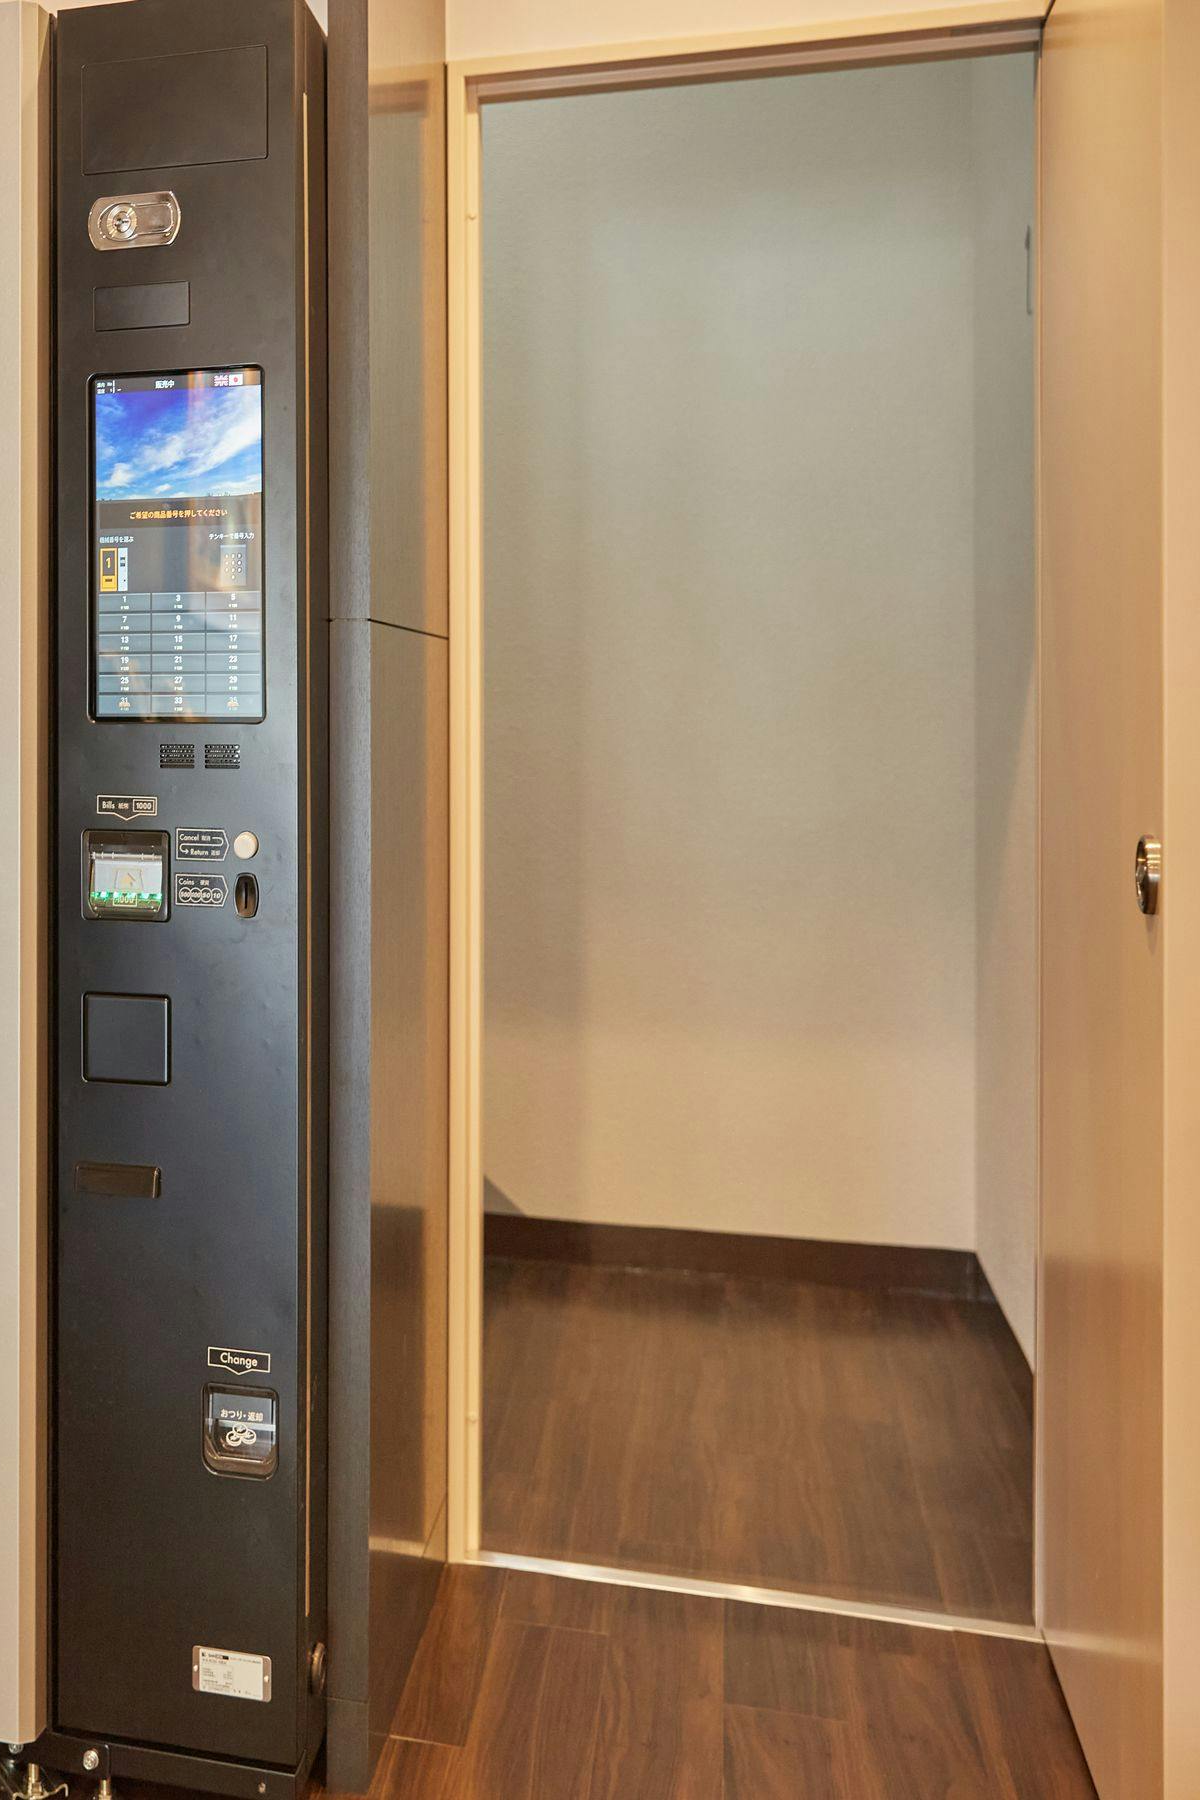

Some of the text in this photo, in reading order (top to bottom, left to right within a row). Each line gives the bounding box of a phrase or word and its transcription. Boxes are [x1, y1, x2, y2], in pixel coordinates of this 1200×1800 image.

[105, 557, 112, 569] 1
[102, 801, 115, 809] Bills
[136, 802, 152, 810] 1000
[179, 833, 199, 841] Cancel
[190, 848, 209, 856] Return
[202, 891, 210, 899] 50
[213, 891, 221, 899] 10
[220, 1352, 258, 1369] Change
